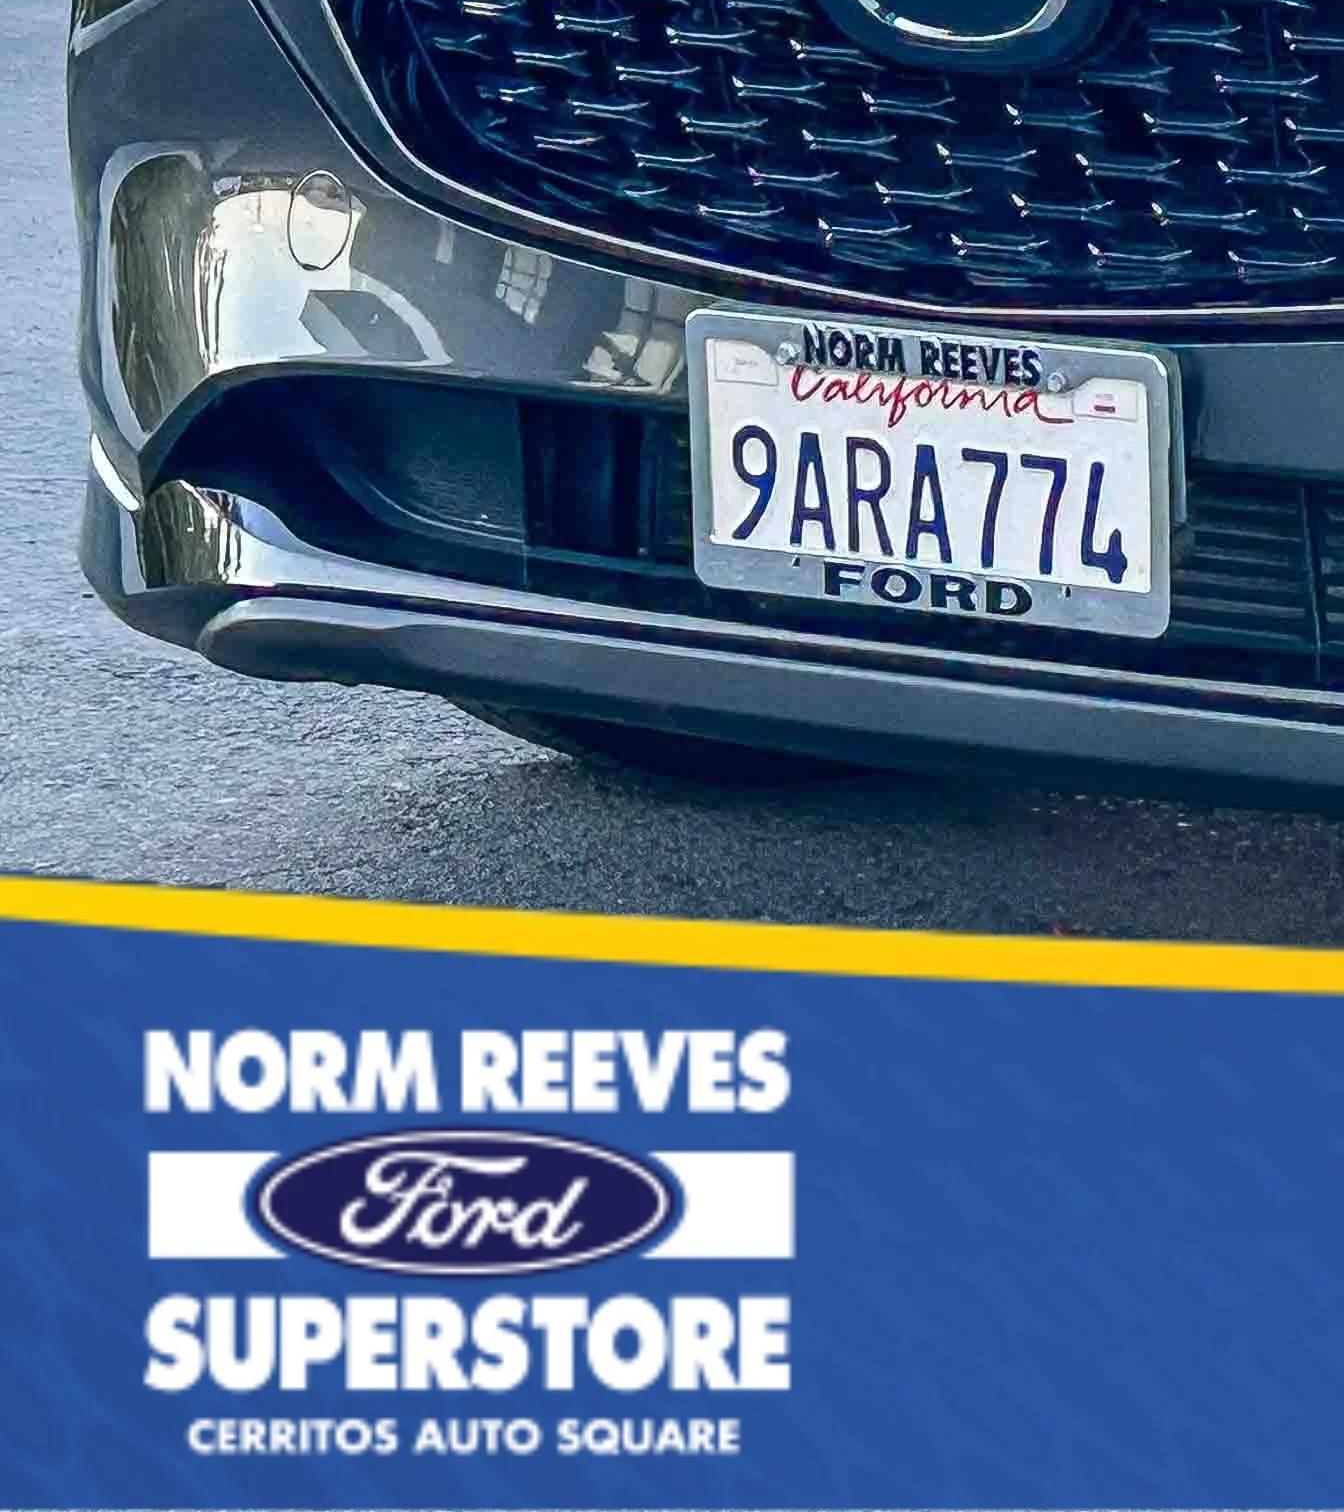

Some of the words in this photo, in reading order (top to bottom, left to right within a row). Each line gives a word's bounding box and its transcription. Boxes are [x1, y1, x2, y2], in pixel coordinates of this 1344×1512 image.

[803, 325, 906, 375] NORM
[921, 340, 1043, 387] REEVES
[790, 364, 1075, 428] California
[731, 424, 1128, 584] 9ARA774
[823, 560, 1033, 615] FORD
